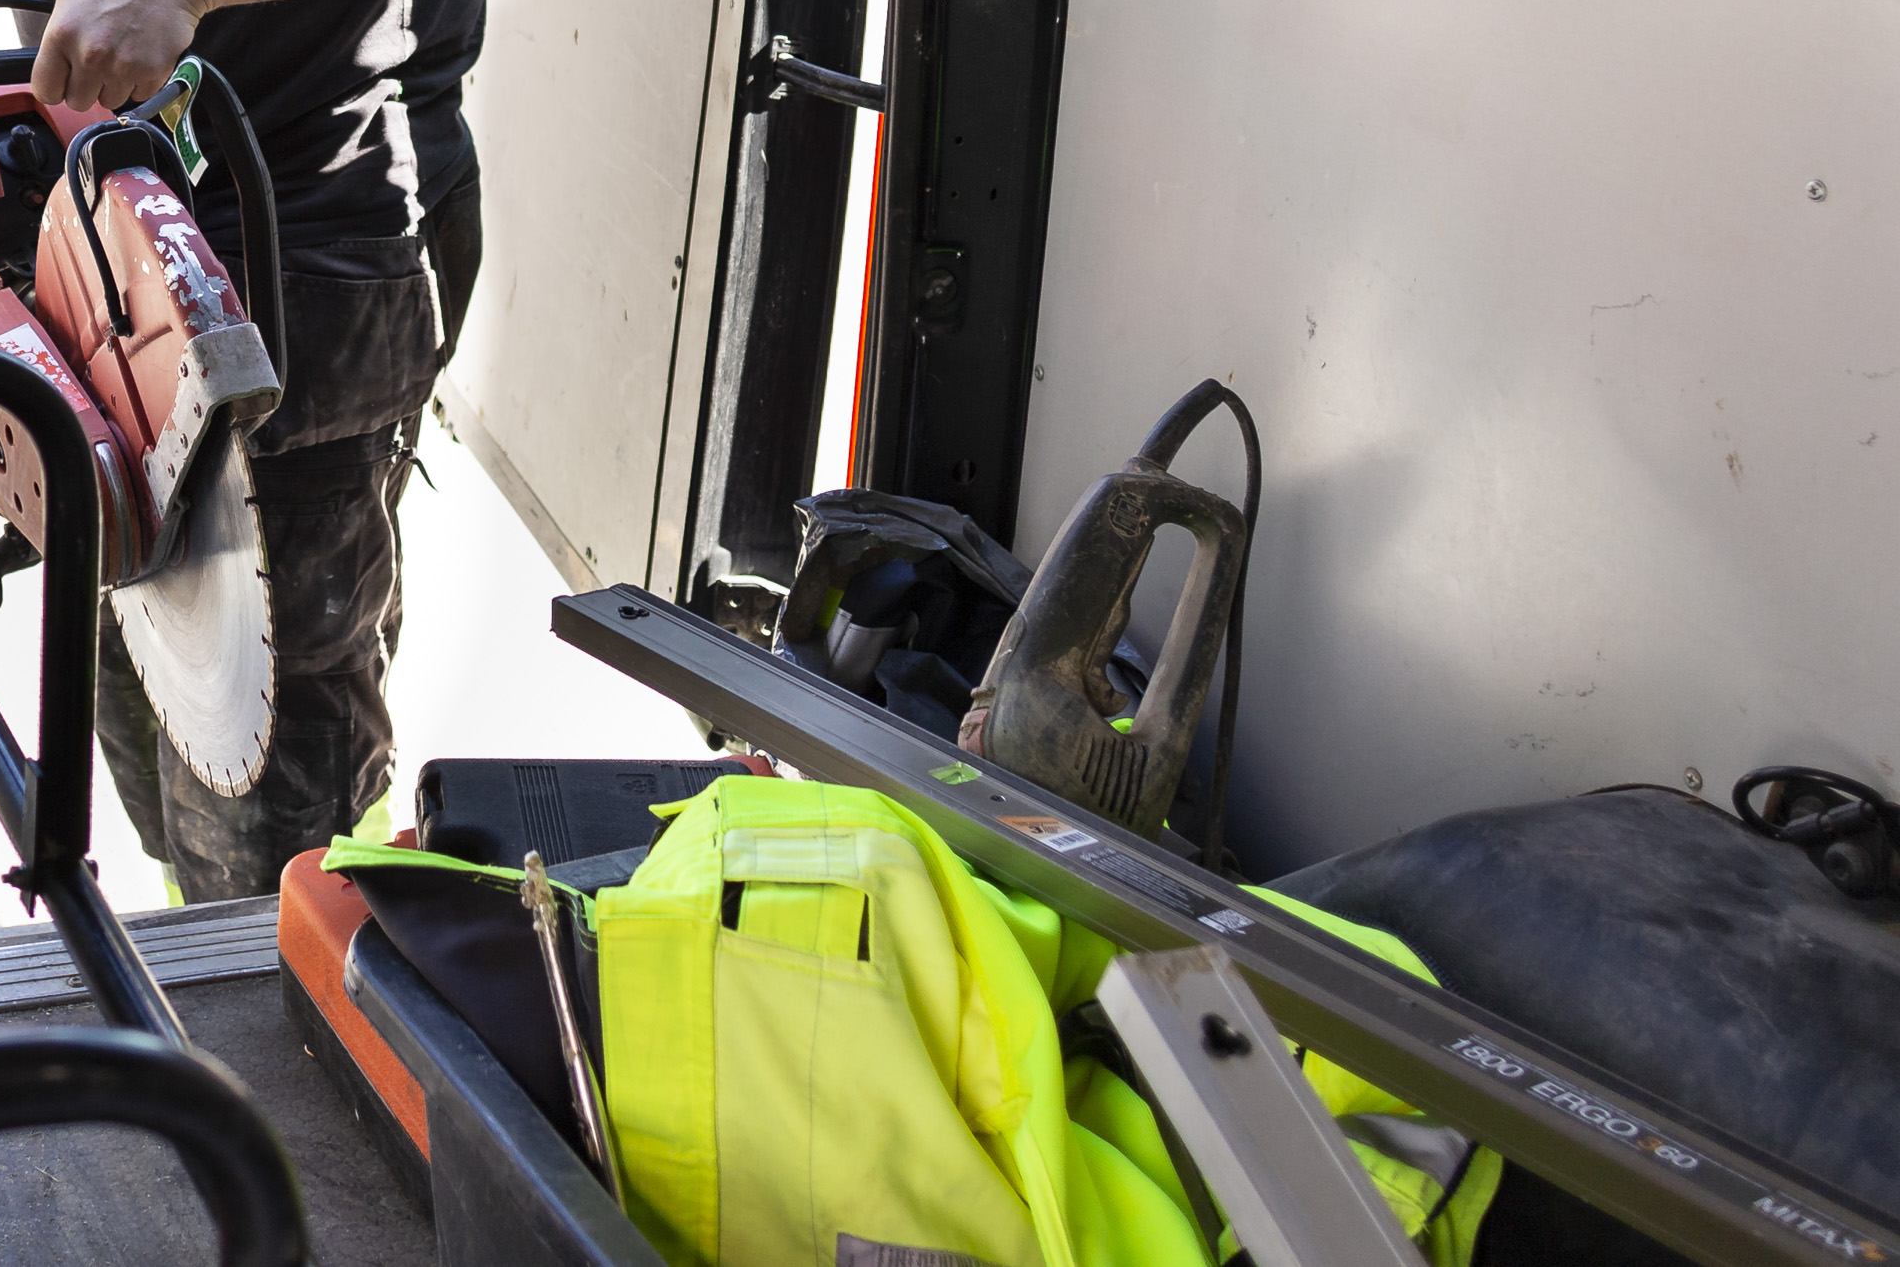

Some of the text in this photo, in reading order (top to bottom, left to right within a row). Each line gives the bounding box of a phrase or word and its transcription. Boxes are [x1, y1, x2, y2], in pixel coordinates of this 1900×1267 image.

[1450, 1037, 1698, 1169] 1800 ERGO 360
